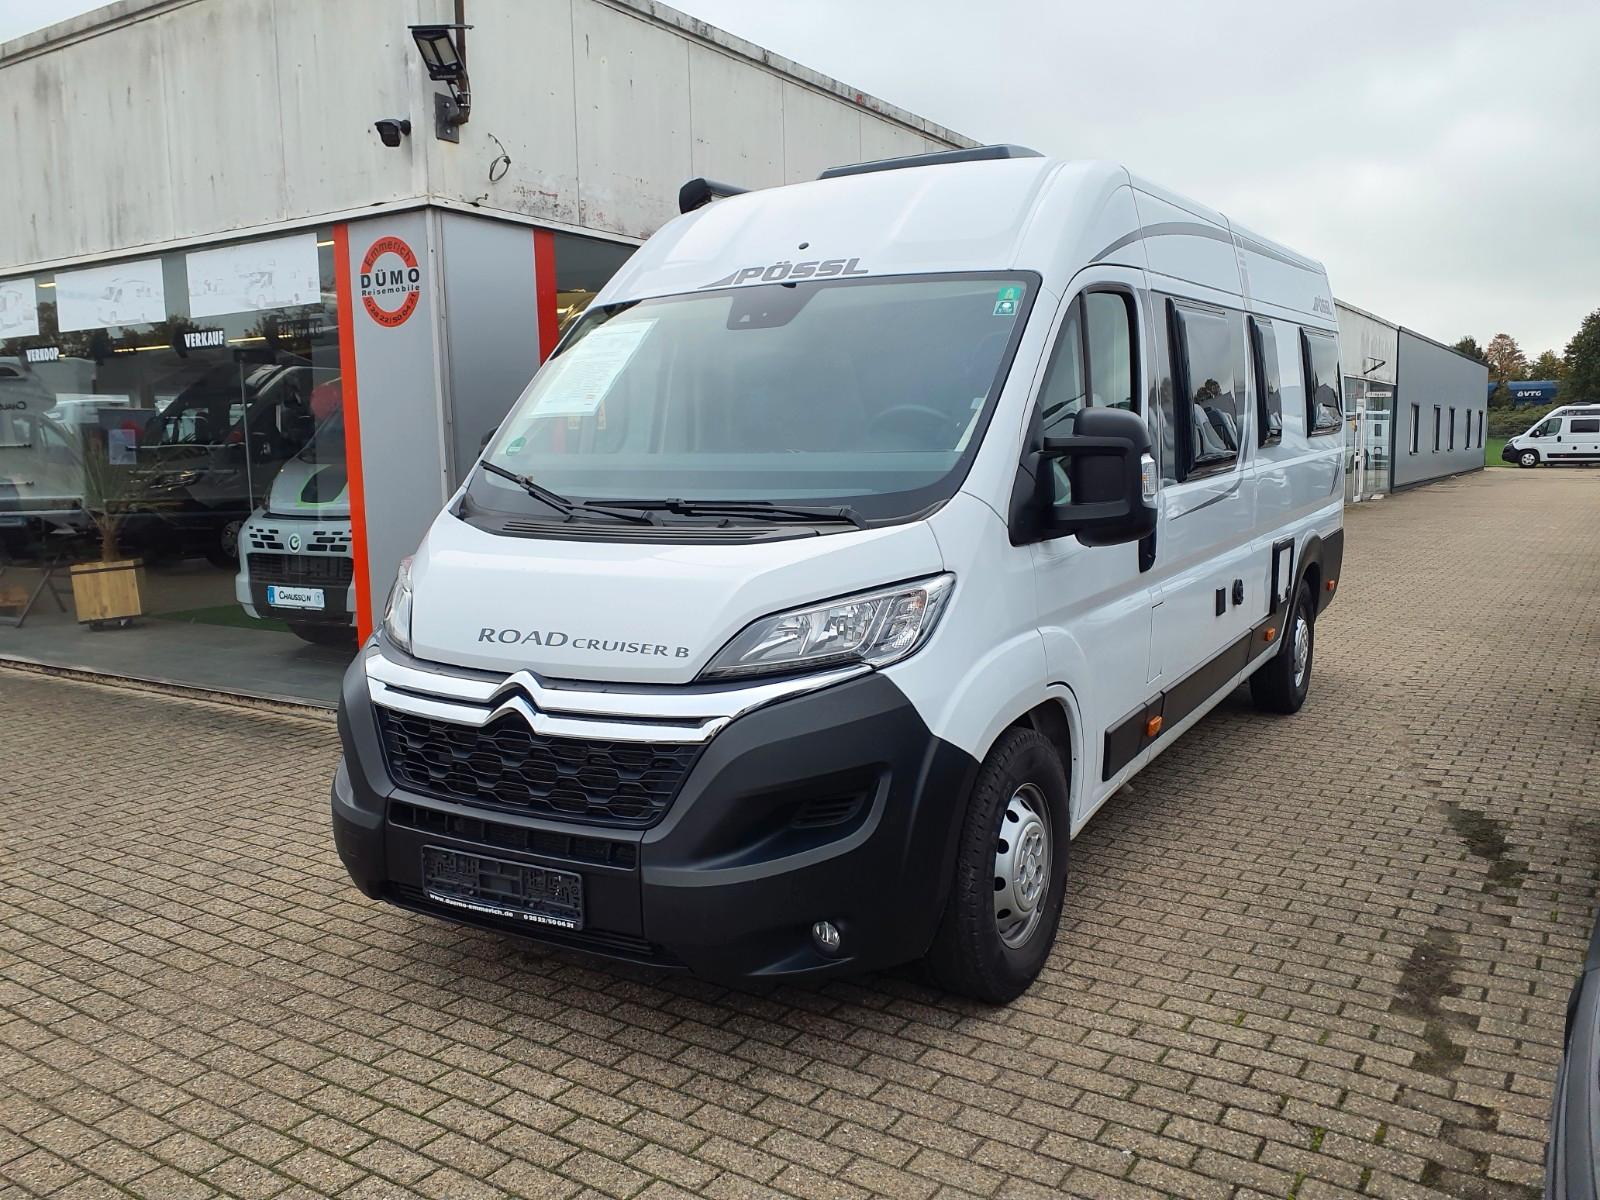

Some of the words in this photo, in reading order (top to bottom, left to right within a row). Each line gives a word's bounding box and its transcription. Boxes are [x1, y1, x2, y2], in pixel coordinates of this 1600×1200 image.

[364, 241, 411, 266] Emmerich
[361, 269, 420, 288] DÜMO
[733, 258, 868, 284] PÖSSL
[361, 284, 420, 297] Reisemobile
[184, 331, 224, 348] VERKAUF
[26, 347, 59, 362] VERKOOP
[478, 628, 568, 647] ROAD
[572, 638, 669, 657] CRUISER
[675, 646, 689, 658] B
